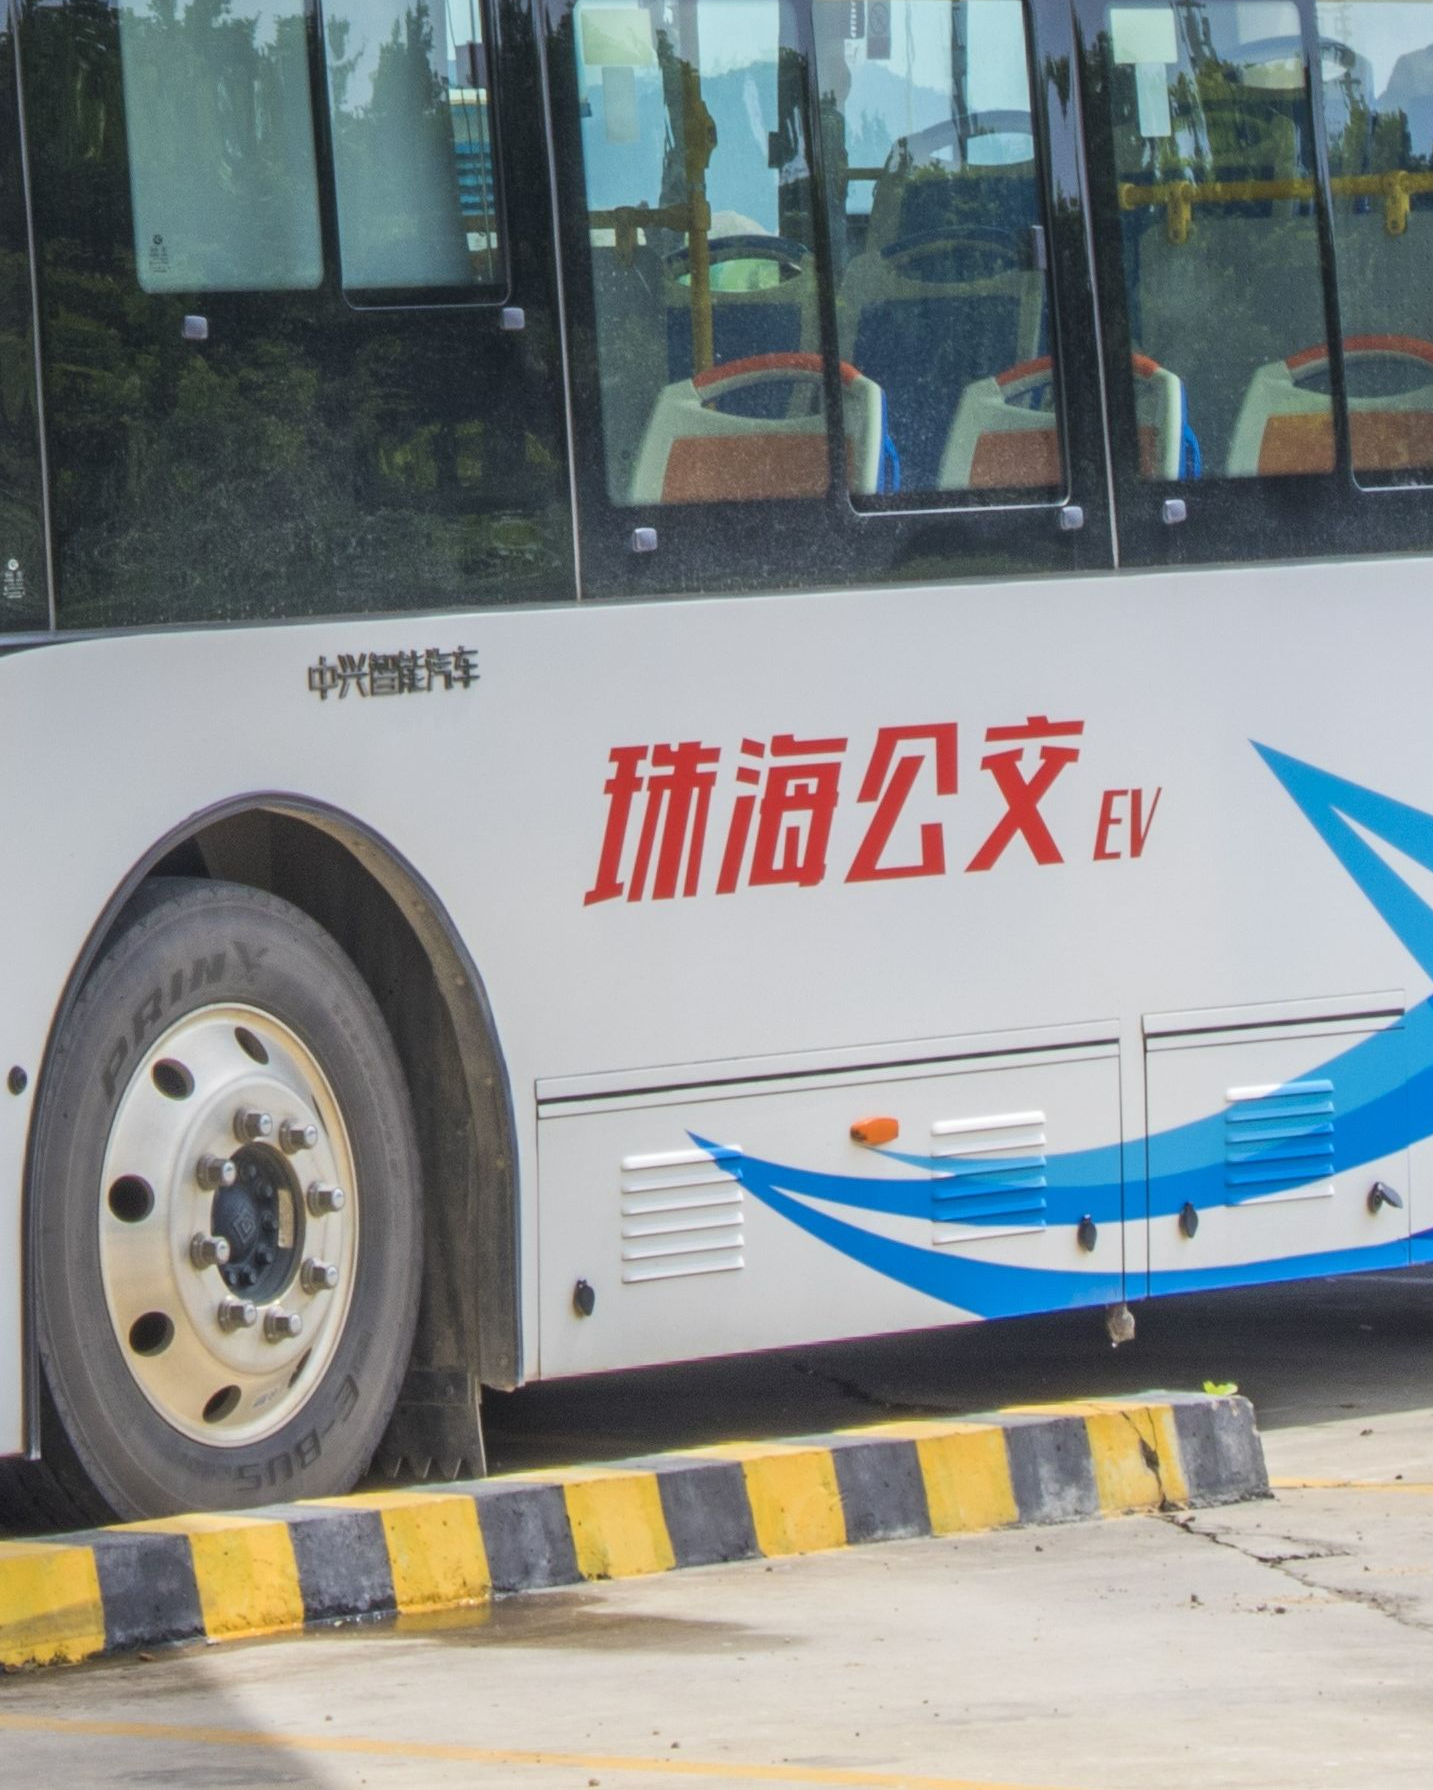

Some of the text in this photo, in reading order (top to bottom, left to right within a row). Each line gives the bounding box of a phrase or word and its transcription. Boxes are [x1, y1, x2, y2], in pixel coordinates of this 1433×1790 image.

[308, 645, 481, 700] 中兴智能汽车
[582, 715, 1162, 908] 珠海公交 EV
[102, 940, 269, 1105] PRINX
[235, 1373, 360, 1492] E-BUS
